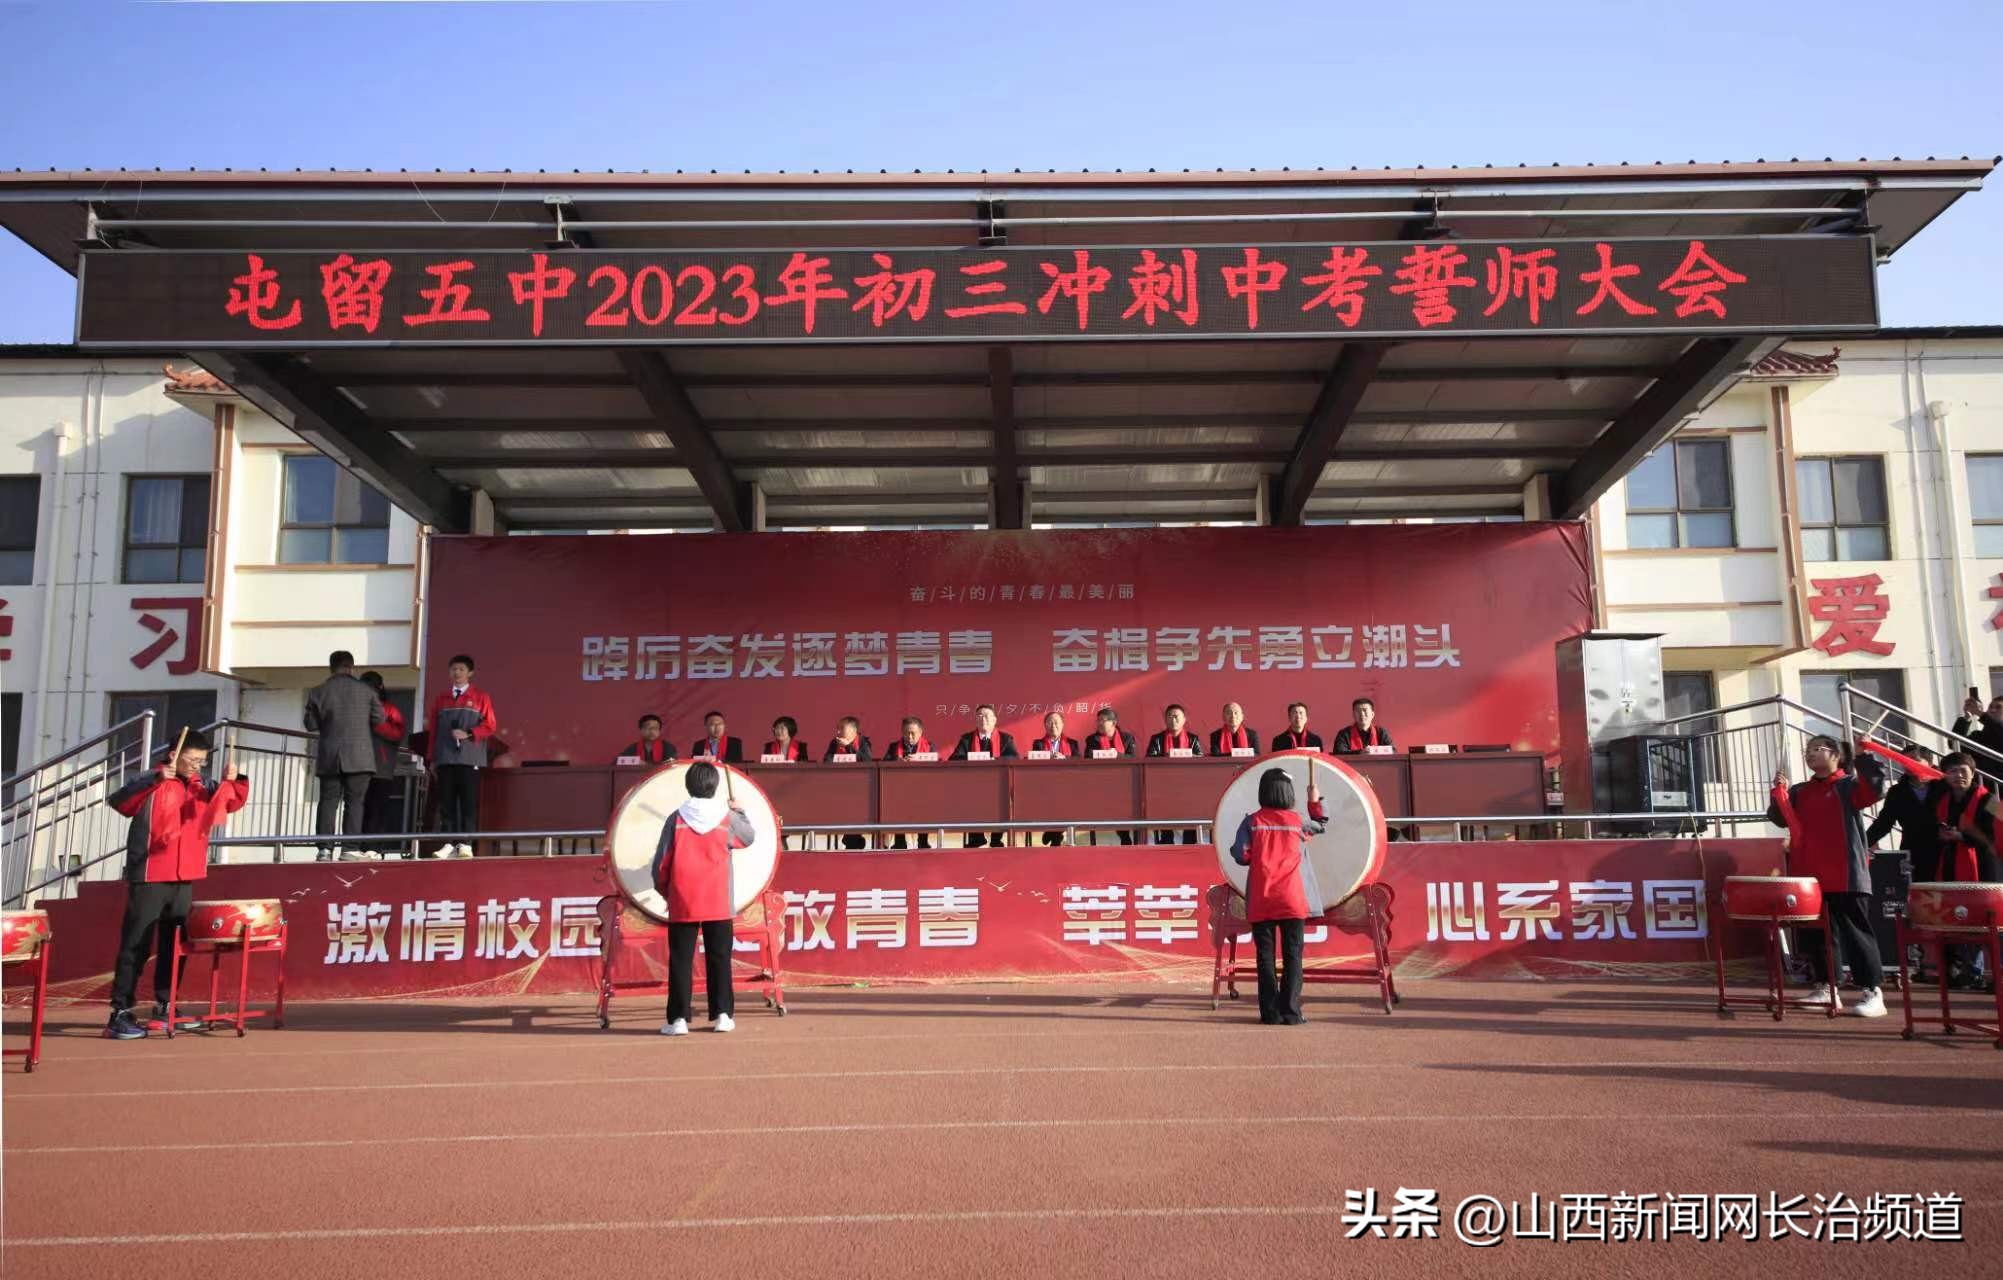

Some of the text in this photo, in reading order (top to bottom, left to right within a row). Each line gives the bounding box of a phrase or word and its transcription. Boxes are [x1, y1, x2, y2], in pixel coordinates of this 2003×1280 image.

[224, 240, 1749, 337] 屯留五中2023年初三冲刺中考誓师大会
[130, 597, 204, 676] 习
[582, 622, 1461, 681] 踔厉奋发逐梦青春 奋楫争先勇立潮头
[1809, 573, 1896, 657] 爱
[323, 897, 603, 965] 激情校园
[1426, 880, 1709, 942] 心系家国
